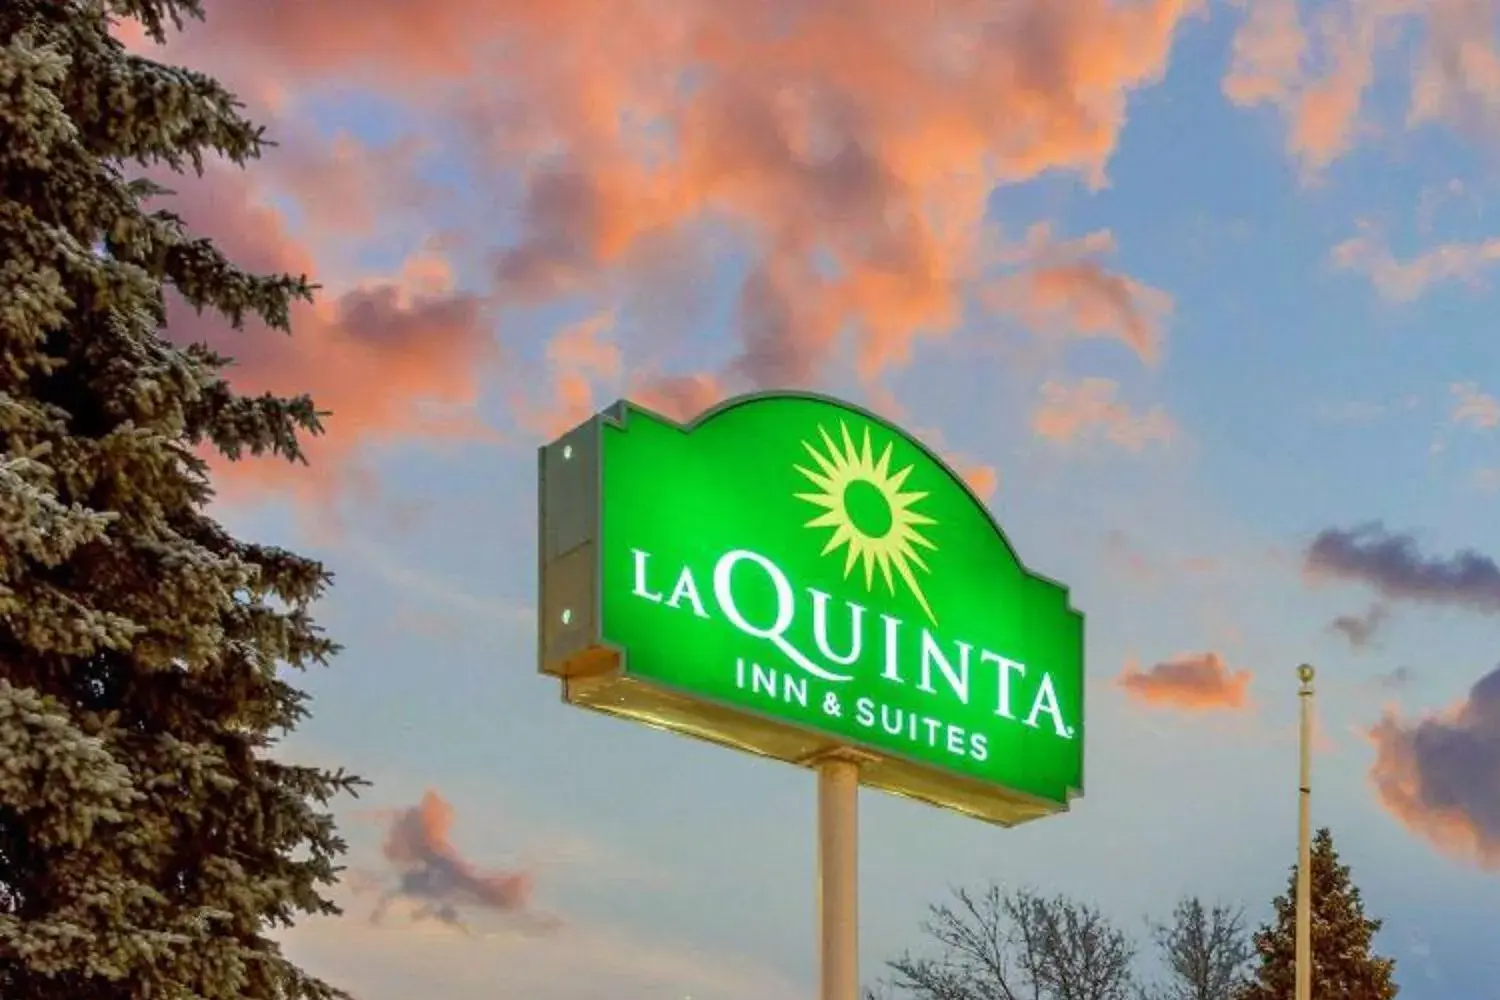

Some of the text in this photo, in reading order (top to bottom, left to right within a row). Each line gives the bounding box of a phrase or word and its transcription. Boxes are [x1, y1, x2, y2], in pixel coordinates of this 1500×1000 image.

[630, 548, 1072, 738] LA QUINTA
[737, 657, 988, 762] INN & SUITES
